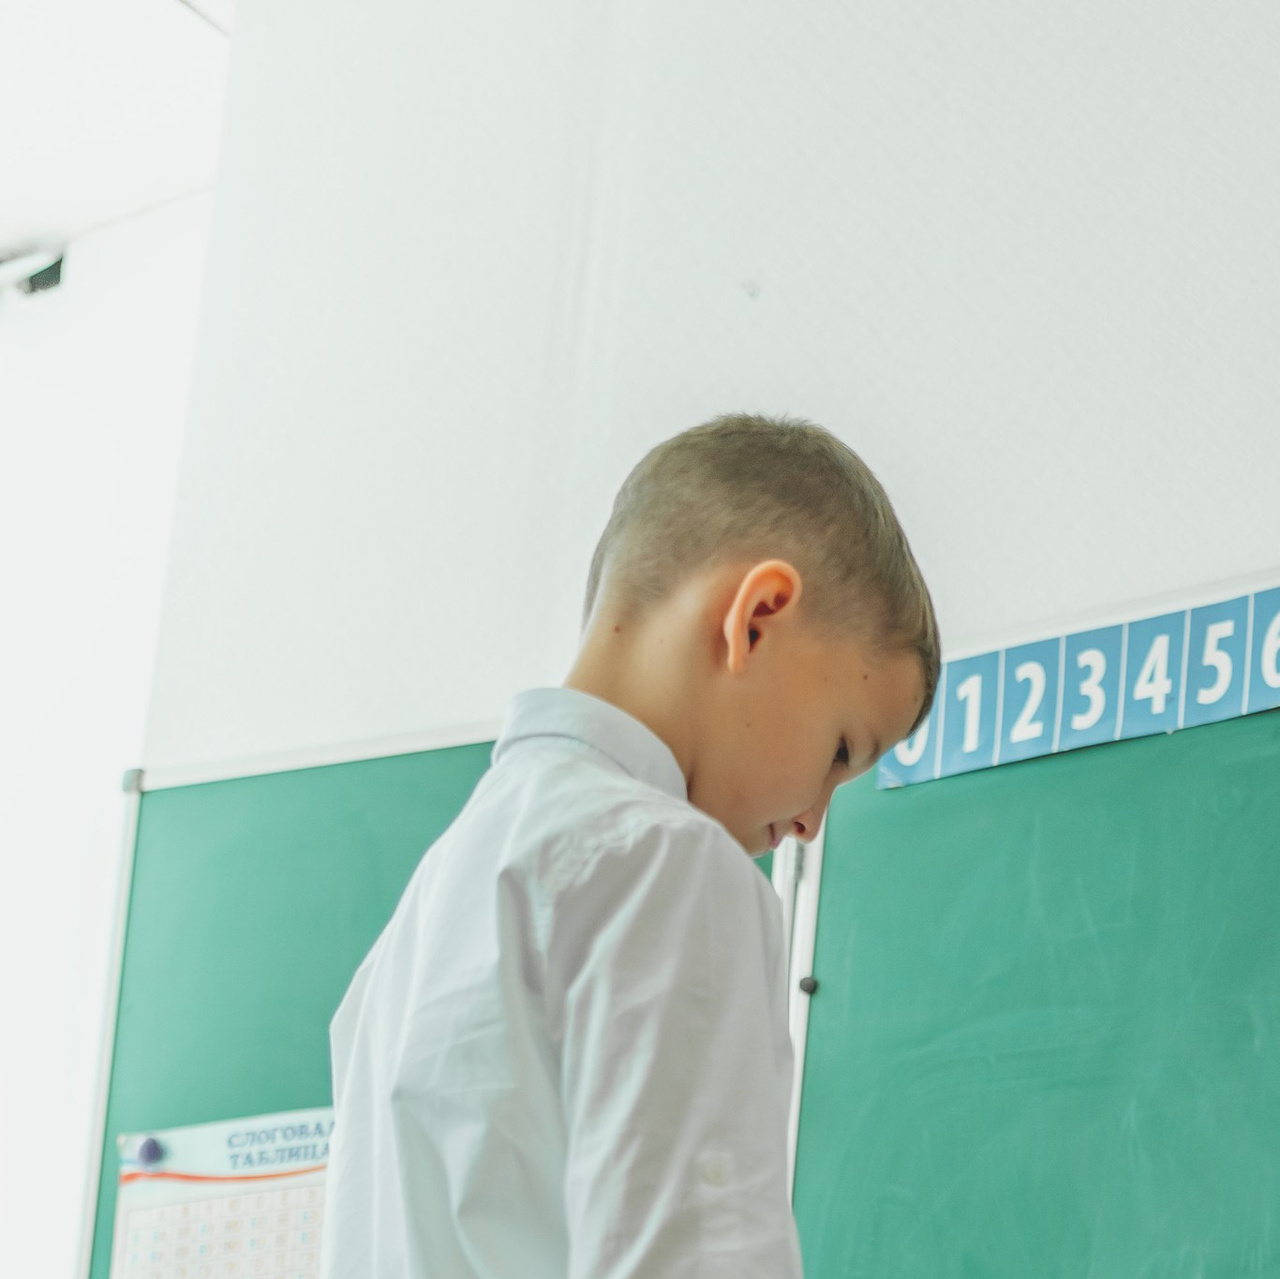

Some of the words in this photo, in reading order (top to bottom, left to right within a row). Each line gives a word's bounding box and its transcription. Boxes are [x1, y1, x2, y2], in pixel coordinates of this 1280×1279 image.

[956, 674, 983, 754] 1
[1009, 661, 1046, 745] 2
[1071, 648, 1107, 731] 3
[1133, 634, 1172, 715] 4
[1196, 619, 1235, 705] 5
[227, 1120, 335, 1148] СЛОГОВА
